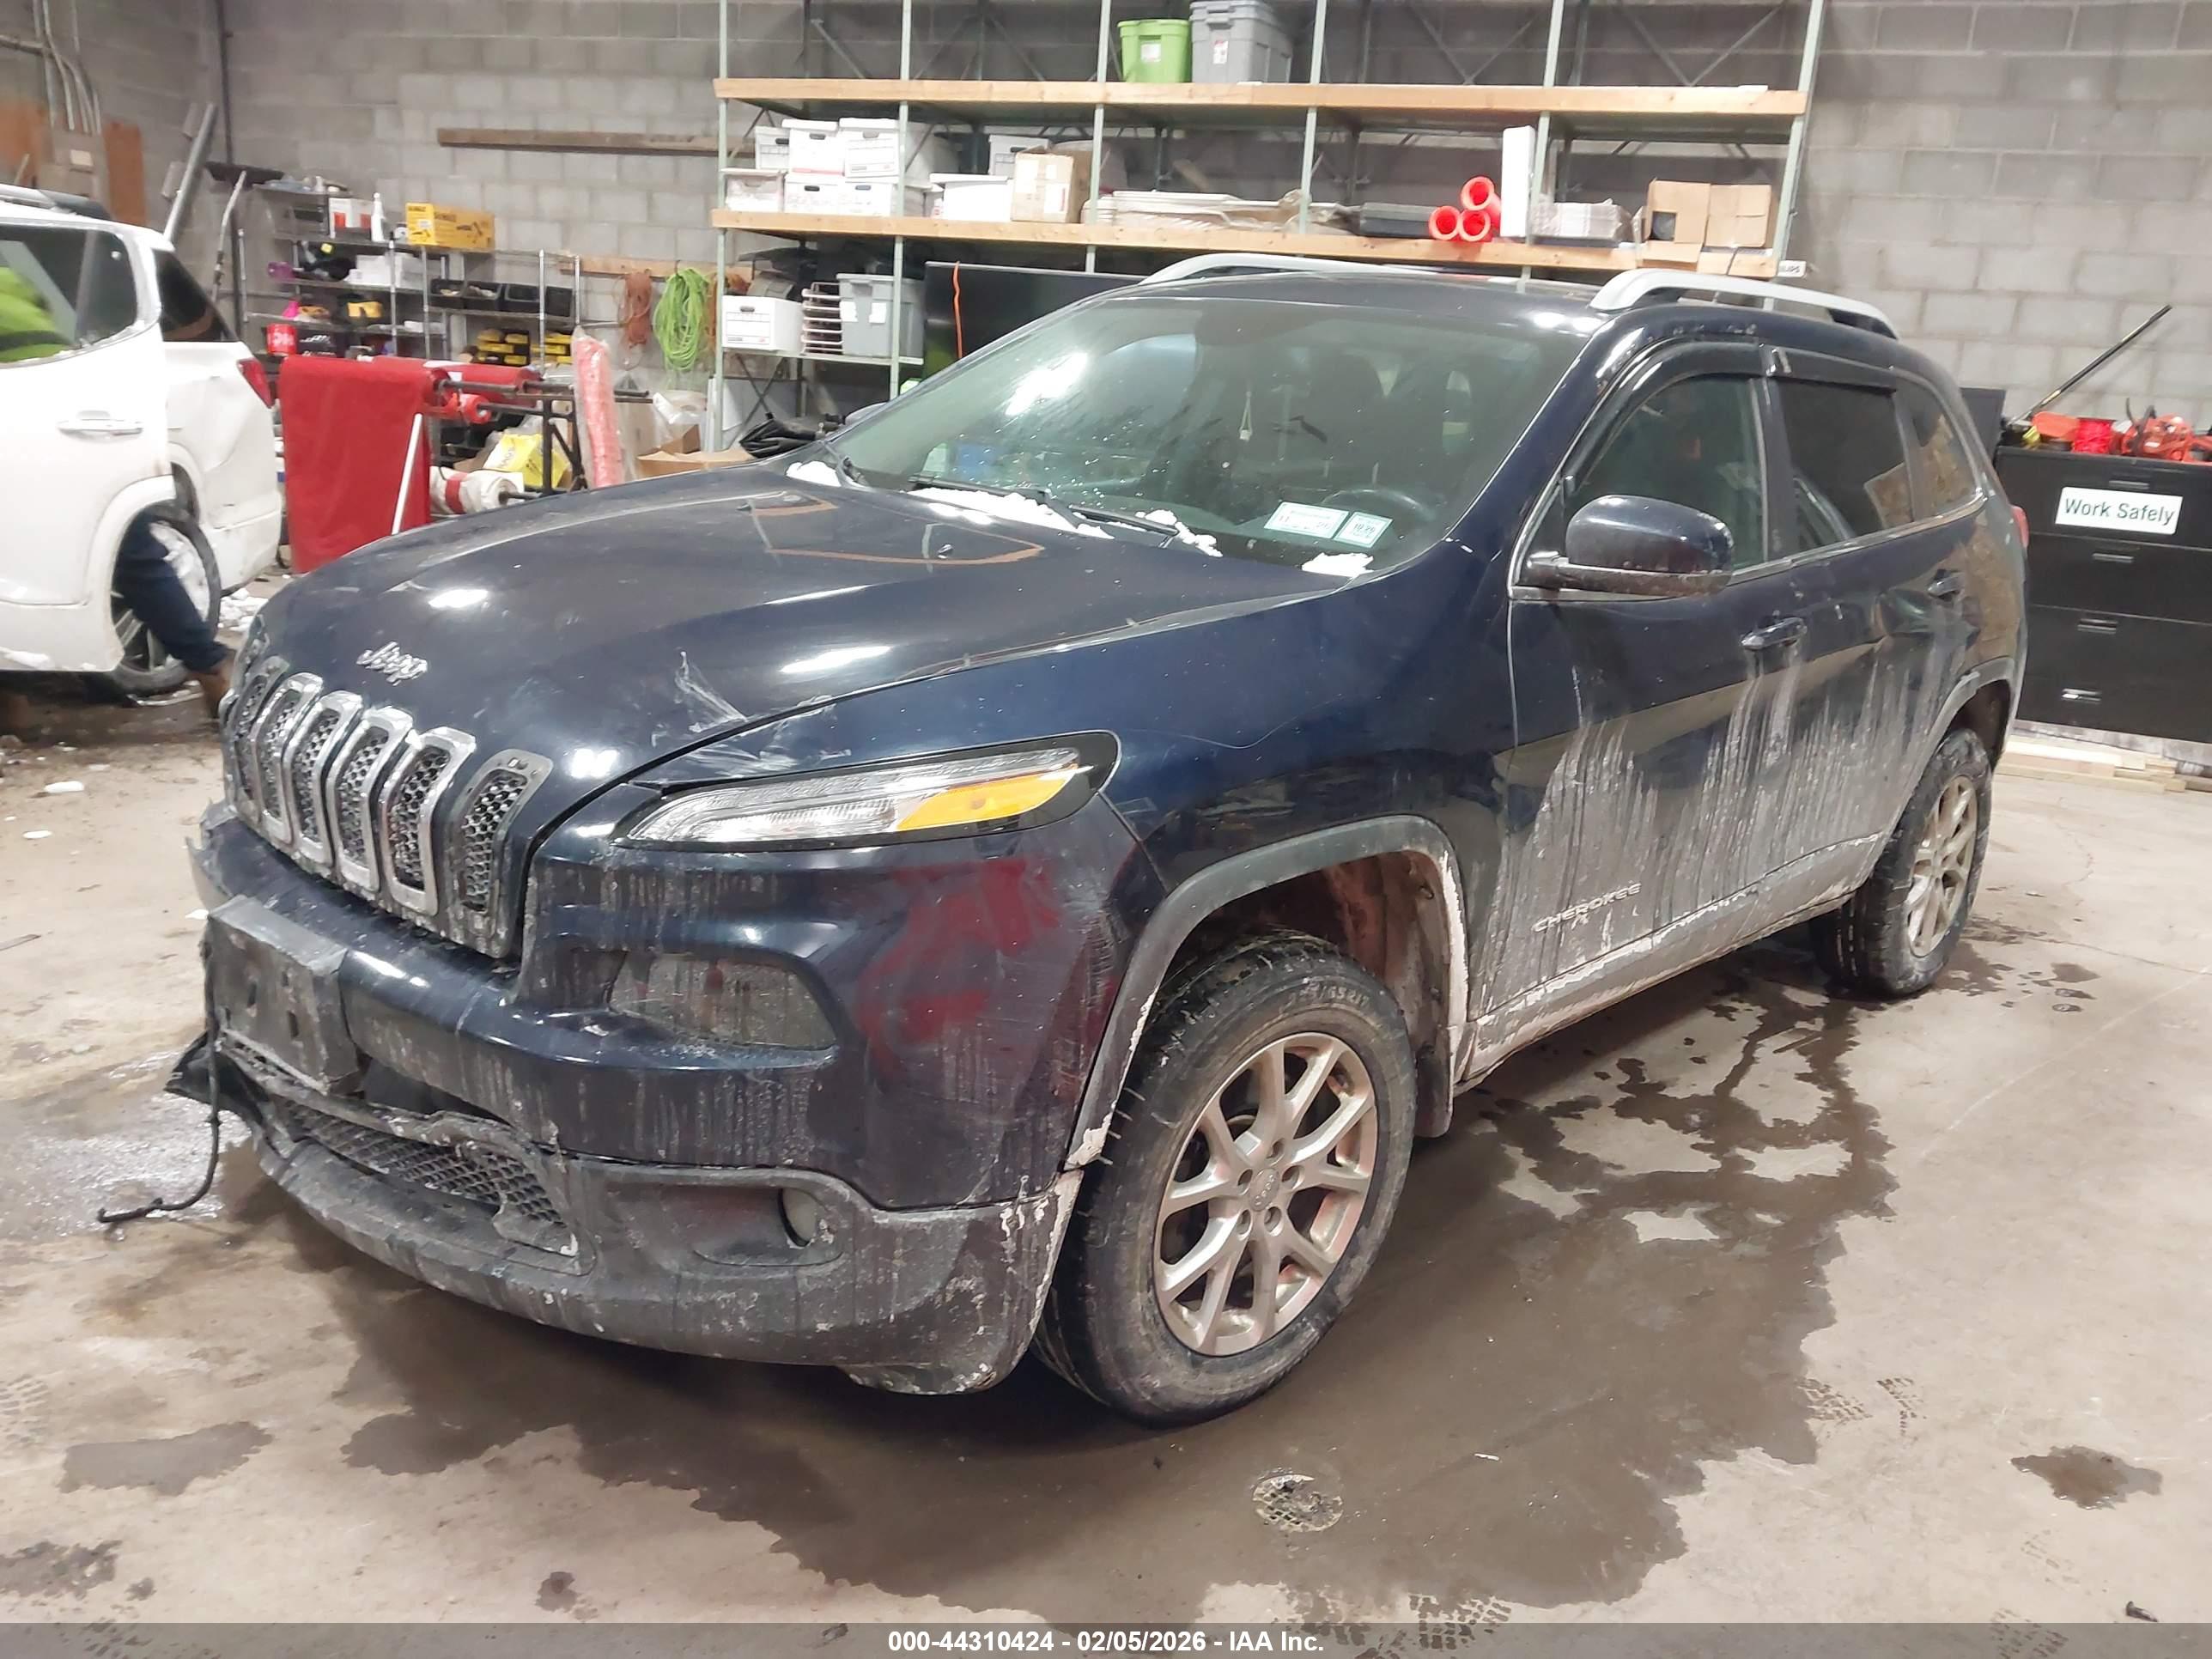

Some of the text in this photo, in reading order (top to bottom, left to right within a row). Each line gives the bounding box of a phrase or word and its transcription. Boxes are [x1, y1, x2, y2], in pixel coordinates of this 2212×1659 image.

[2065, 498, 2175, 526] Work Safely
[1531, 883, 1642, 933] CHEROKEE
